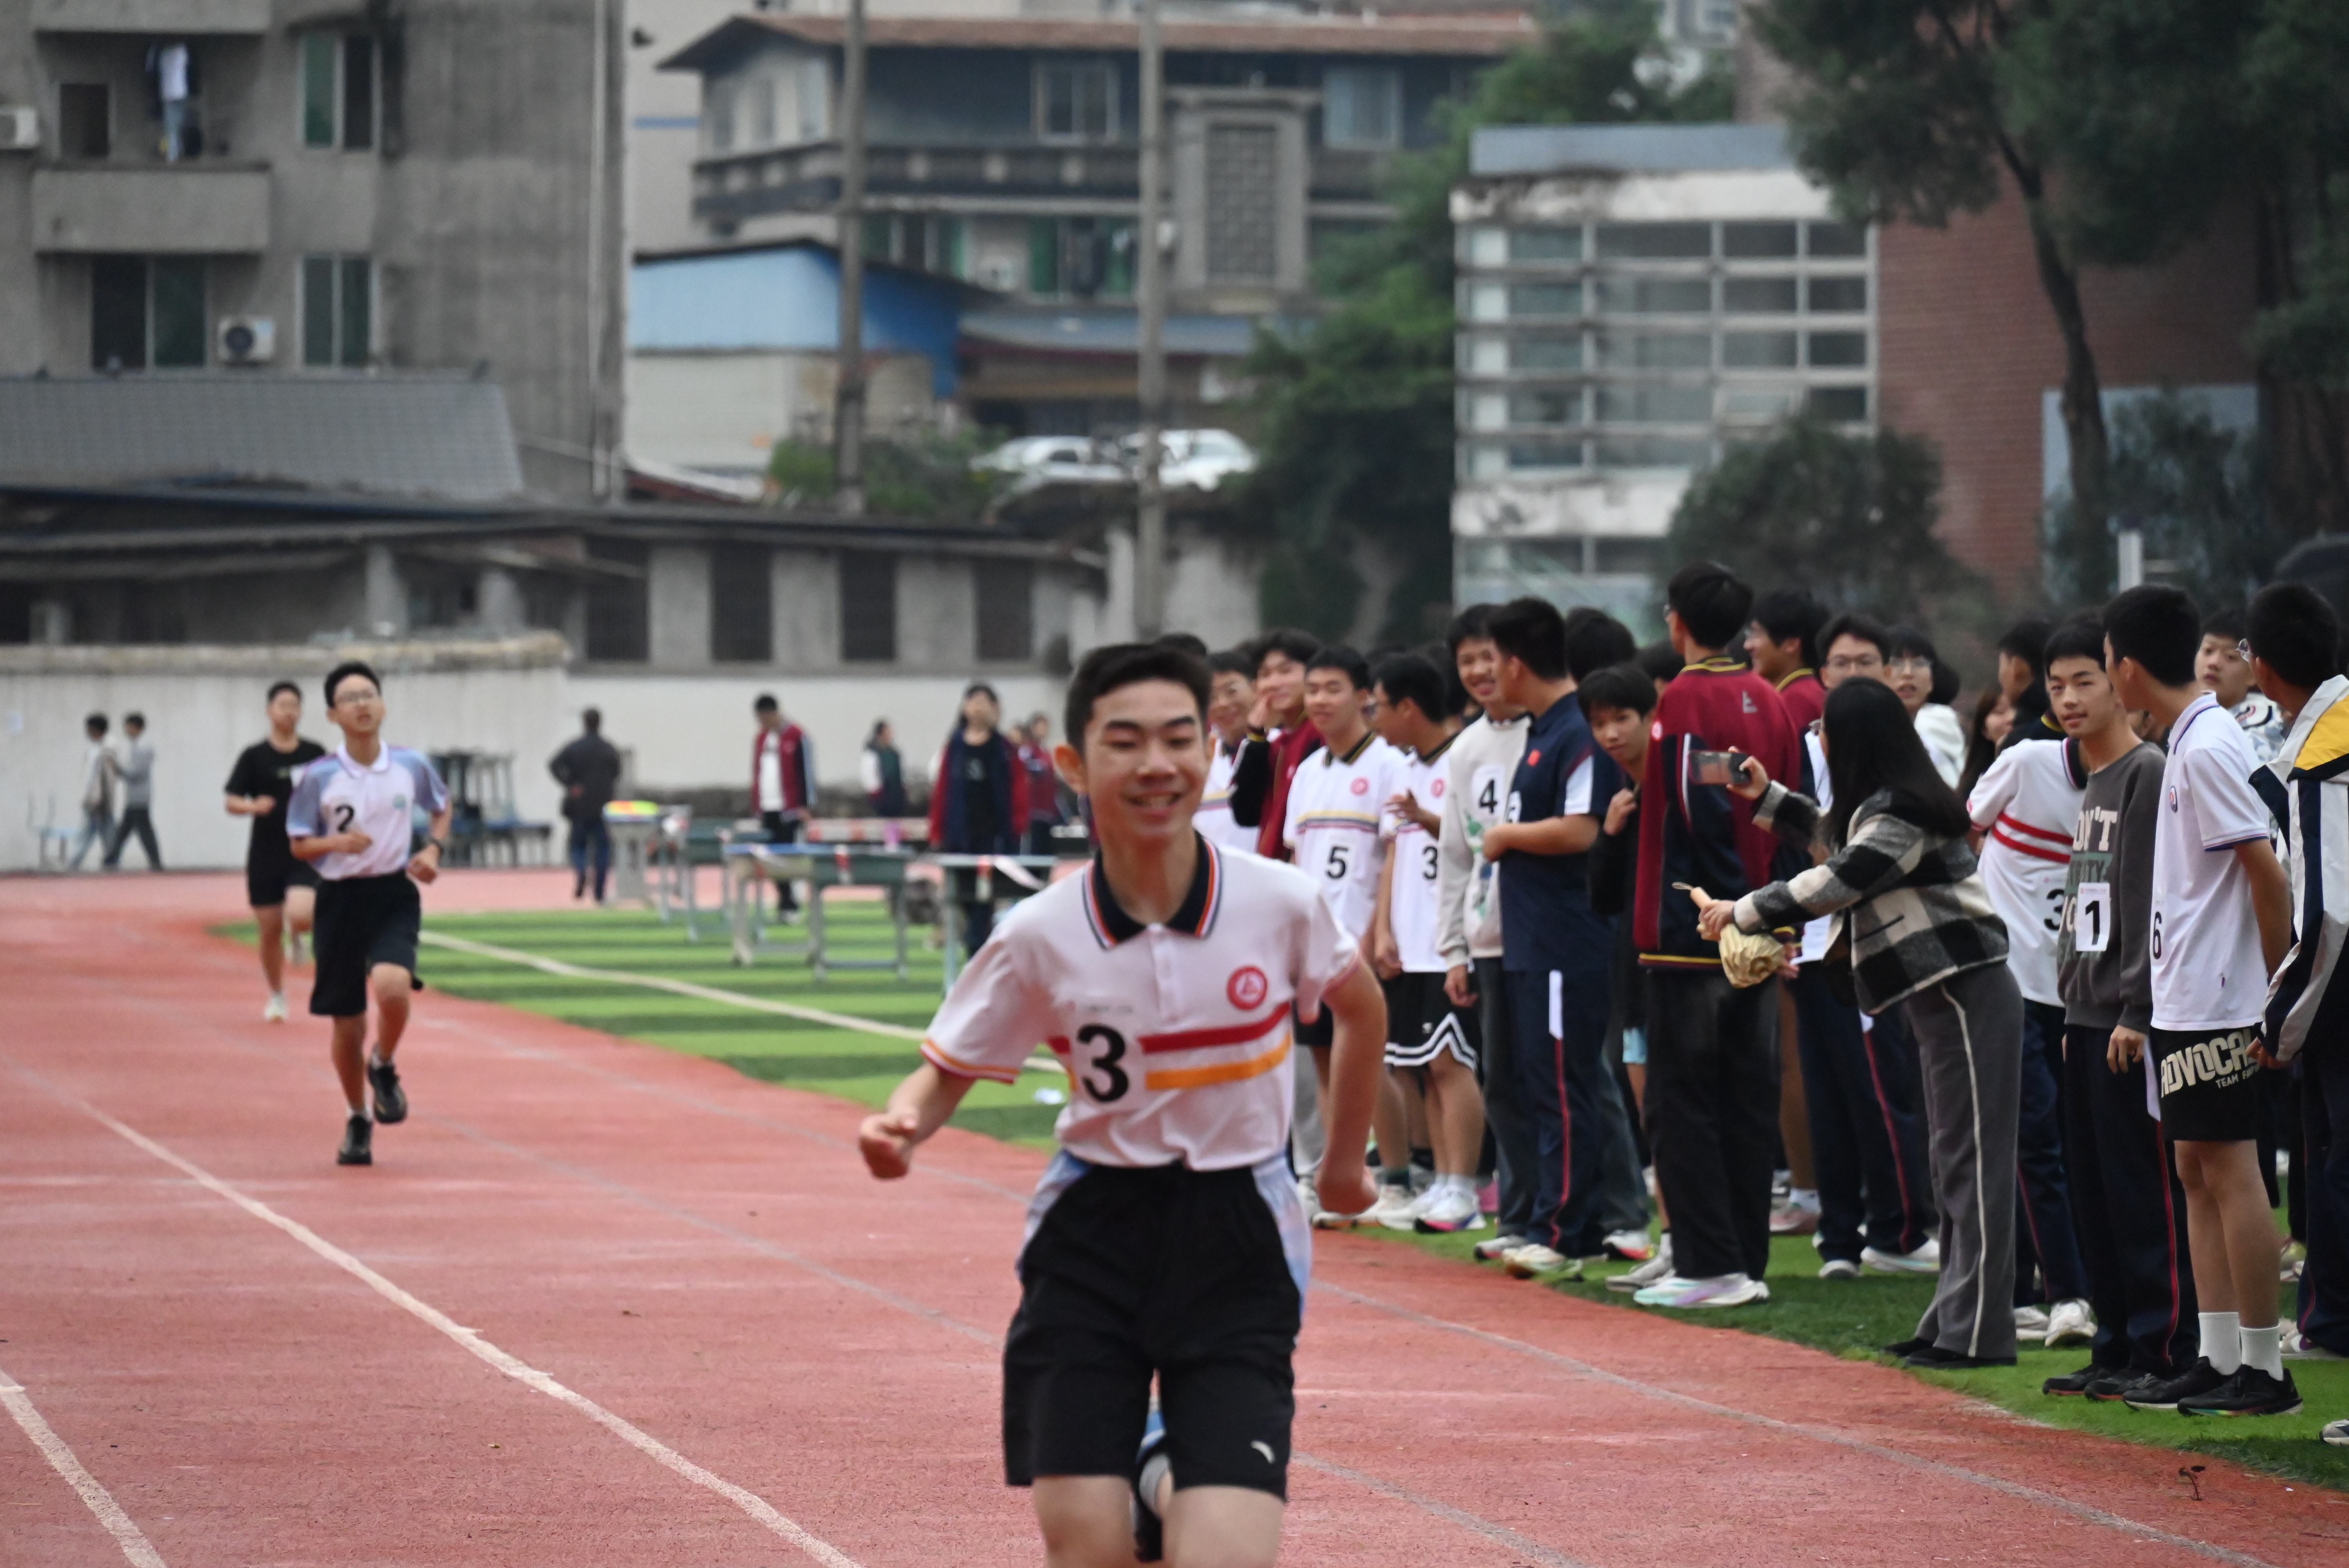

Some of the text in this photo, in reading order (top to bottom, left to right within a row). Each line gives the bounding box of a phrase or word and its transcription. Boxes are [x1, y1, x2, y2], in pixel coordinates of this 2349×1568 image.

[1478, 778, 1498, 814] 4
[335, 804, 355, 833] 2
[1327, 846, 1348, 879] 5
[1422, 846, 1438, 880] 3
[2085, 900, 2100, 946] 1
[2152, 911, 2162, 960] 6
[1076, 1023, 1129, 1104] 3
[2215, 1073, 2239, 1089] TEAM
